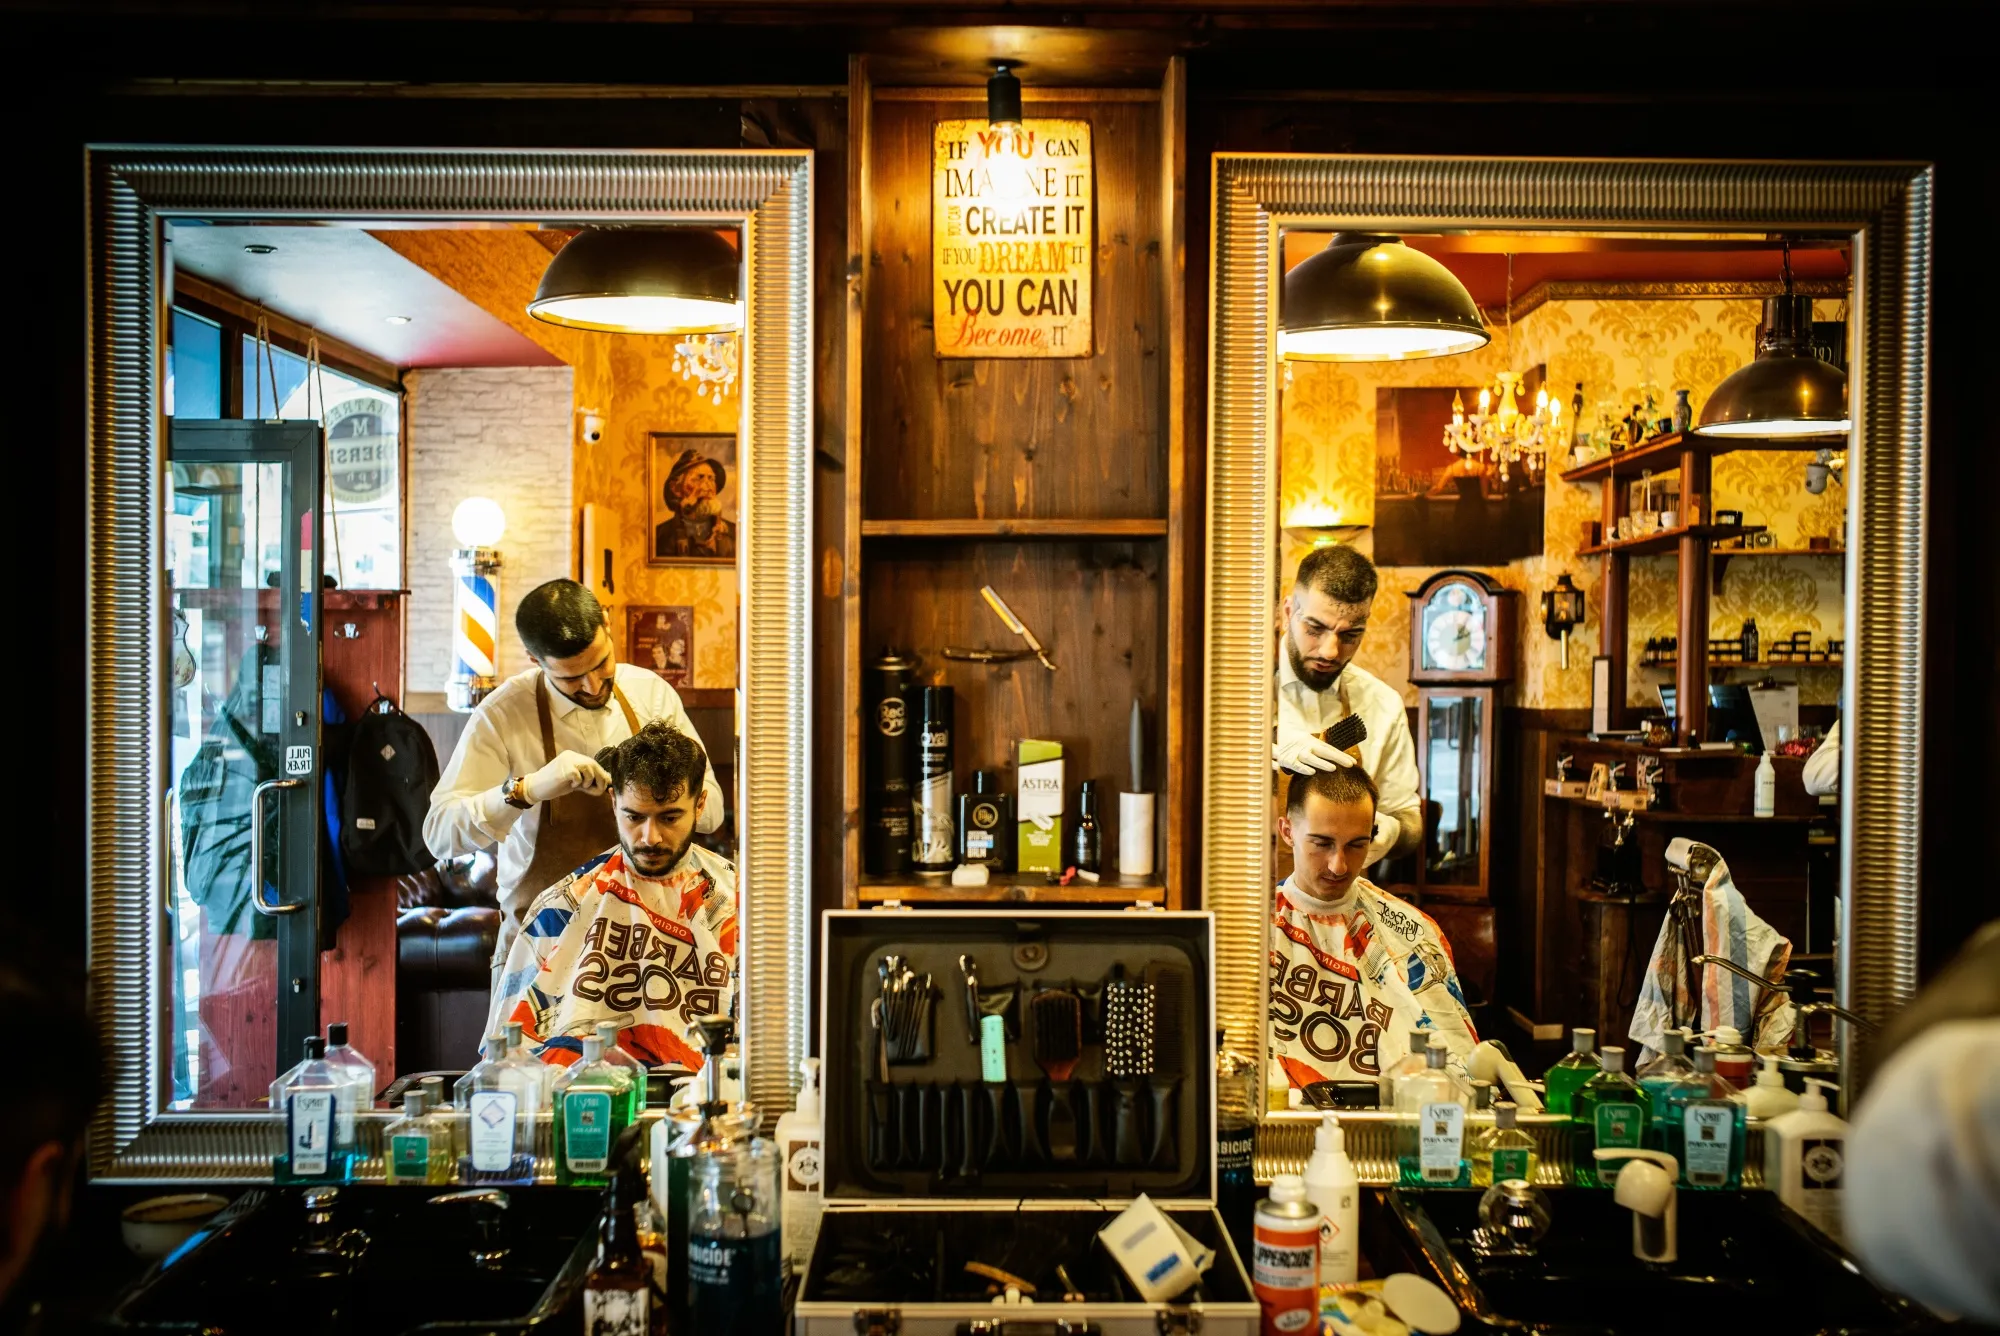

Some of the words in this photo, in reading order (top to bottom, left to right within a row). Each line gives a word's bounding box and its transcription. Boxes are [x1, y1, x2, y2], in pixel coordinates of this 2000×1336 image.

[948, 141, 968, 159] IF
[977, 131, 1034, 159] YOU
[1046, 139, 1079, 157] CAN
[945, 167, 1057, 198] IMANE
[1065, 175, 1084, 197] IT
[966, 206, 1055, 235] CREATE
[1065, 206, 1084, 234] IT
[942, 248, 953, 265] IF
[953, 248, 977, 265] YOU
[978, 241, 1069, 274] DREAM
[1071, 246, 1085, 263] IT
[943, 279, 1004, 316] YOU
[1017, 279, 1077, 316] CAN
[952, 311, 1043, 347] Become
[1052, 326, 1068, 346] IT
[1021, 777, 1059, 791] ASTRA
